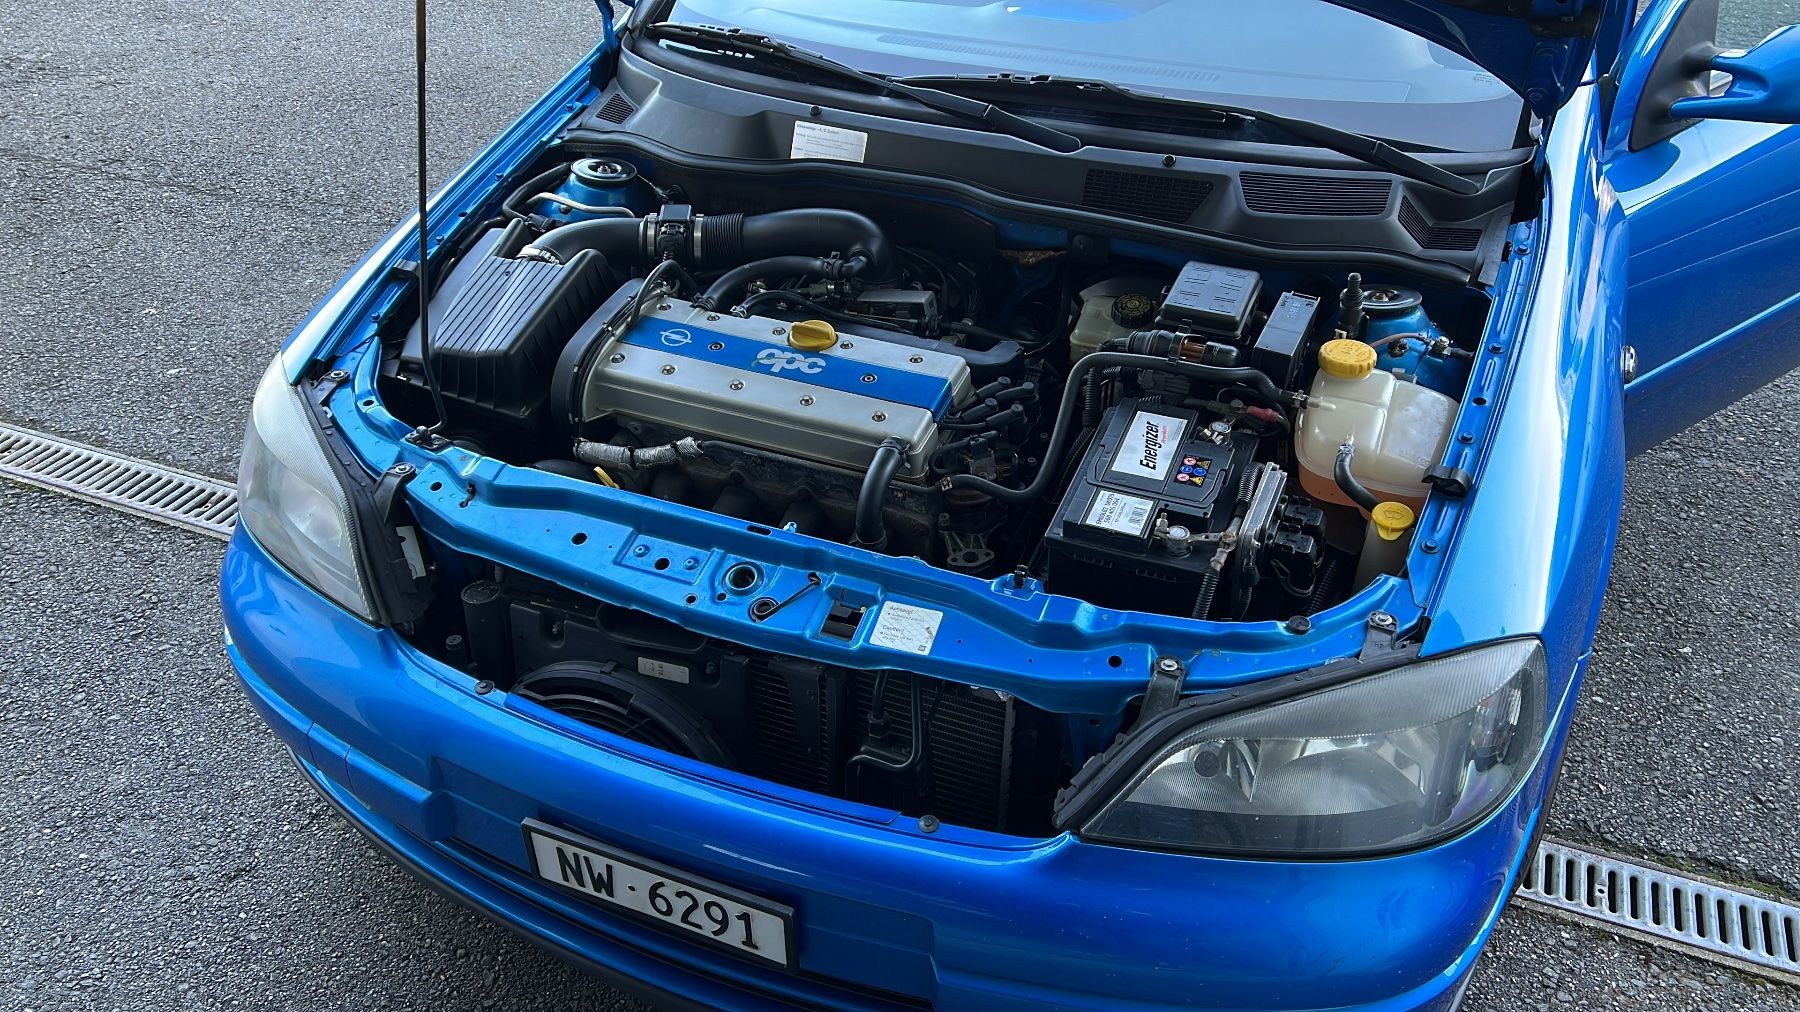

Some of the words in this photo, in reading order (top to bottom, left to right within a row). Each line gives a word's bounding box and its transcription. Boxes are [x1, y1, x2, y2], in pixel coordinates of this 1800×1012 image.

[1140, 421, 1162, 470] Energizer
[556, 846, 615, 898] NW
[648, 881, 759, 951] 6291
